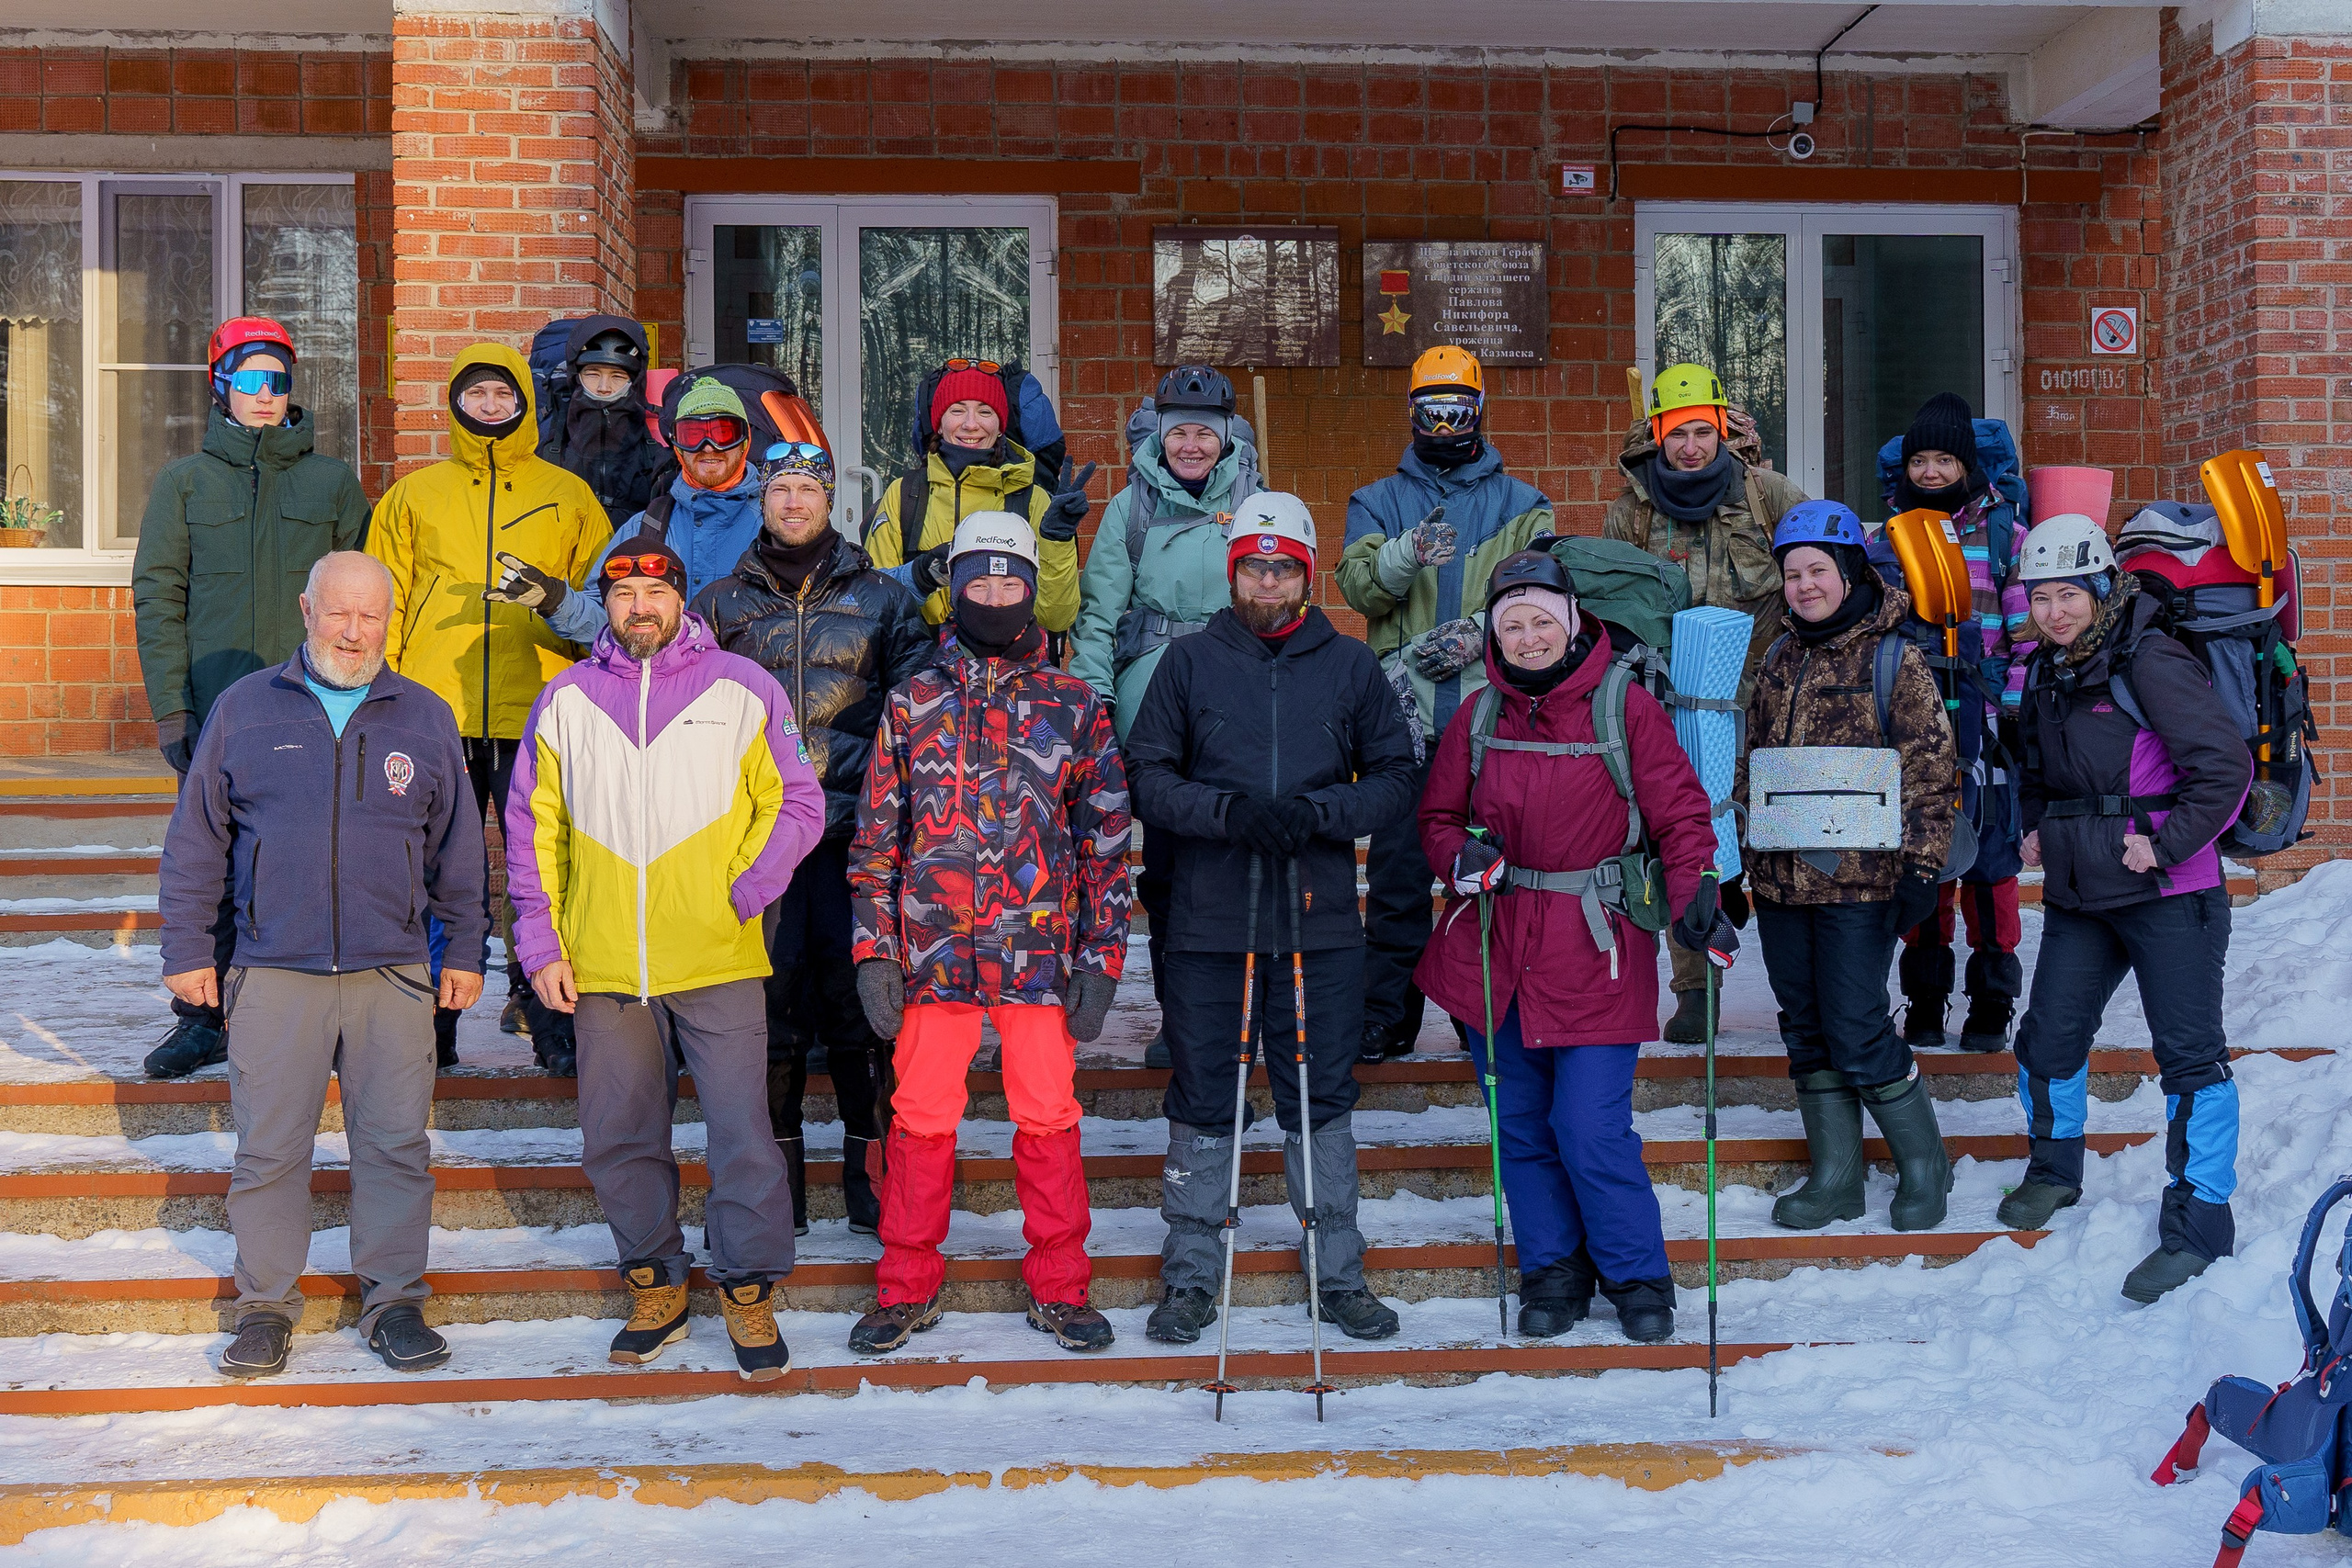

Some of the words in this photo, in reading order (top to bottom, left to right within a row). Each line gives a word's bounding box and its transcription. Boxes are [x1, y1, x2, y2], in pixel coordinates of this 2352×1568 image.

[1463, 248, 1498, 256] имени
[1502, 247, 1534, 258] Героя
[1424, 260, 1489, 269] Советского
[1493, 260, 1529, 269] Союза
[1475, 274, 1531, 283] младшего
[1449, 286, 1502, 296] сержанта
[1448, 296, 1503, 307] Павлова
[1442, 310, 1510, 321] Никифора
[1433, 321, 1522, 333] Савельевича,
[1449, 337, 1503, 346] уроженца
[1480, 348, 1534, 357] Казмаска
[975, 536, 1007, 545] RedFox
